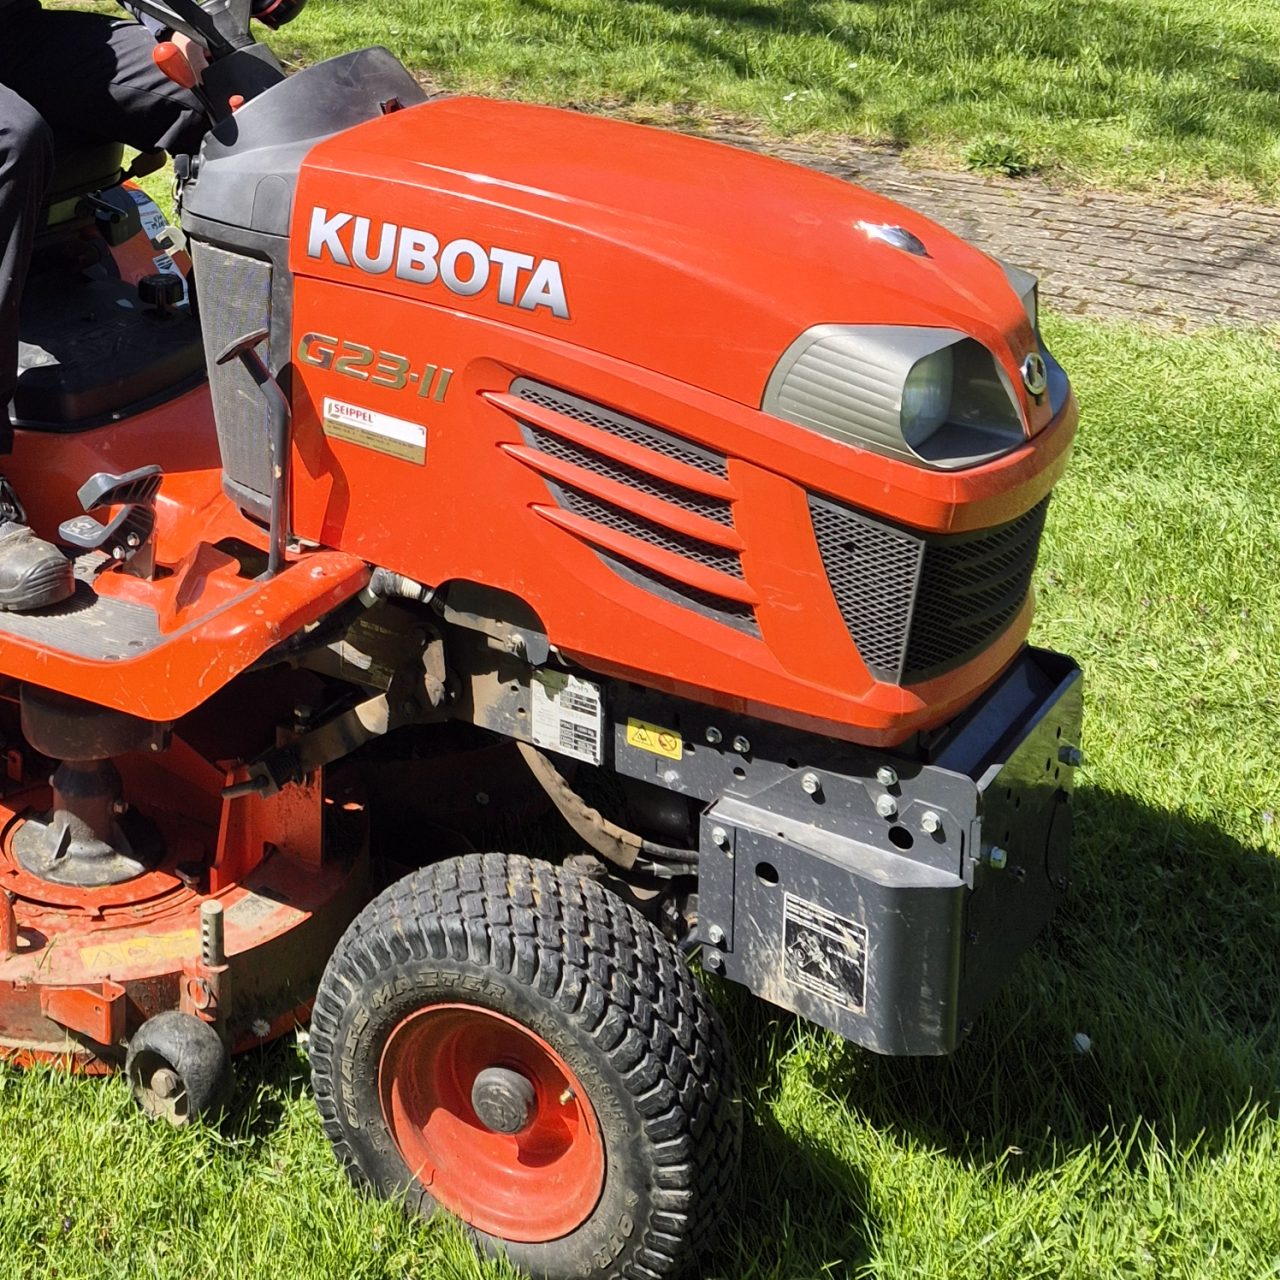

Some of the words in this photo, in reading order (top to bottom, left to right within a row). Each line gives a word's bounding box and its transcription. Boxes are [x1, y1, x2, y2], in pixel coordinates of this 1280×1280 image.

[306, 206, 571, 320] KUBOTA
[334, 403, 374, 424] SEIPPEL
[341, 1007, 371, 1129] GRASS
[371, 970, 507, 1010] MASTER
